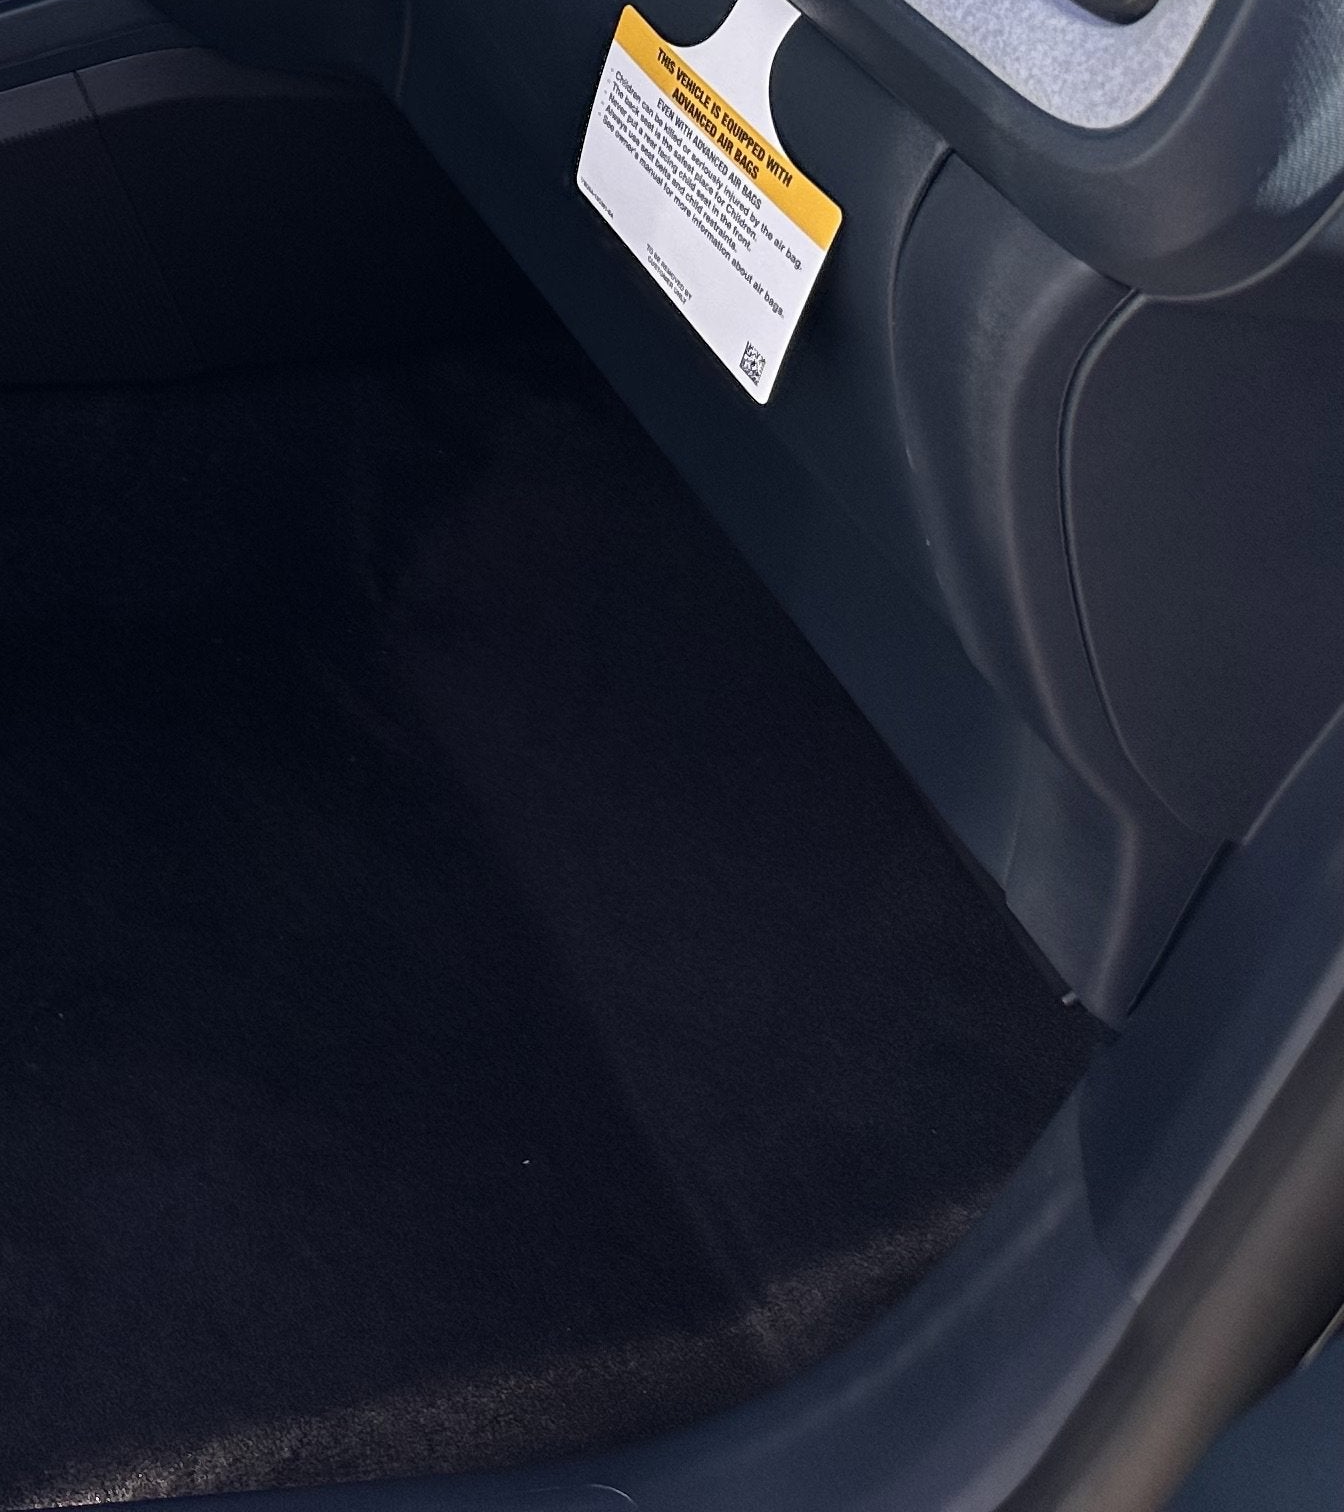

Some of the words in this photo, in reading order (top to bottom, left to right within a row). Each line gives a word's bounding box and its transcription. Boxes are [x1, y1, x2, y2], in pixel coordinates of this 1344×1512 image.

[612, 81, 624, 99] The
[624, 95, 640, 117] back
[640, 114, 655, 132] seat
[654, 127, 661, 140] is
[662, 136, 673, 152] the
[673, 149, 694, 175] safest
[694, 172, 714, 195] place
[714, 191, 726, 207] for
[725, 203, 757, 242] Children.
[615, 70, 642, 104] Children
[641, 101, 654, 117] can
[654, 113, 664, 127] be
[663, 122, 683, 147] killed
[682, 144, 691, 156] or
[691, 153, 723, 190] seriously
[724, 185, 750, 216] injured
[750, 212, 760, 228] by
[760, 222, 773, 241] the
[773, 238, 786, 252] air
[785, 247, 802, 270] bag.
[626, 114, 639, 131] put
[643, 132, 658, 149] rear
[658, 146, 678, 175] facing
[678, 170, 697, 192] child
[696, 189, 712, 208] seat
[712, 203, 720, 217] in
[720, 213, 732, 229] the
[732, 225, 751, 252] front.
[655, 158, 671, 181] belts
[672, 178, 686, 196] and
[685, 192, 703, 215] child
[656, 47, 676, 75] THIS
[676, 67, 712, 109] VEHICLE
[710, 101, 722, 119] IS
[721, 112, 766, 162] EQUIPPED
[766, 155, 793, 188] WITH
[656, 97, 674, 122] EVEN
[674, 115, 694, 140] WITH
[693, 135, 729, 176] ADVANCED
[728, 172, 742, 192] AIR
[741, 185, 762, 210] BAGS
[672, 87, 718, 138] ADVANCED
[716, 132, 734, 156] AIR
[733, 147, 760, 180] BAGS
[639, 157, 663, 186] manual
[663, 182, 673, 197] for
[673, 195, 691, 217] more
[691, 213, 731, 261] information
[731, 258, 753, 284] about
[752, 281, 765, 296] air
[764, 290, 784, 319] bags.
